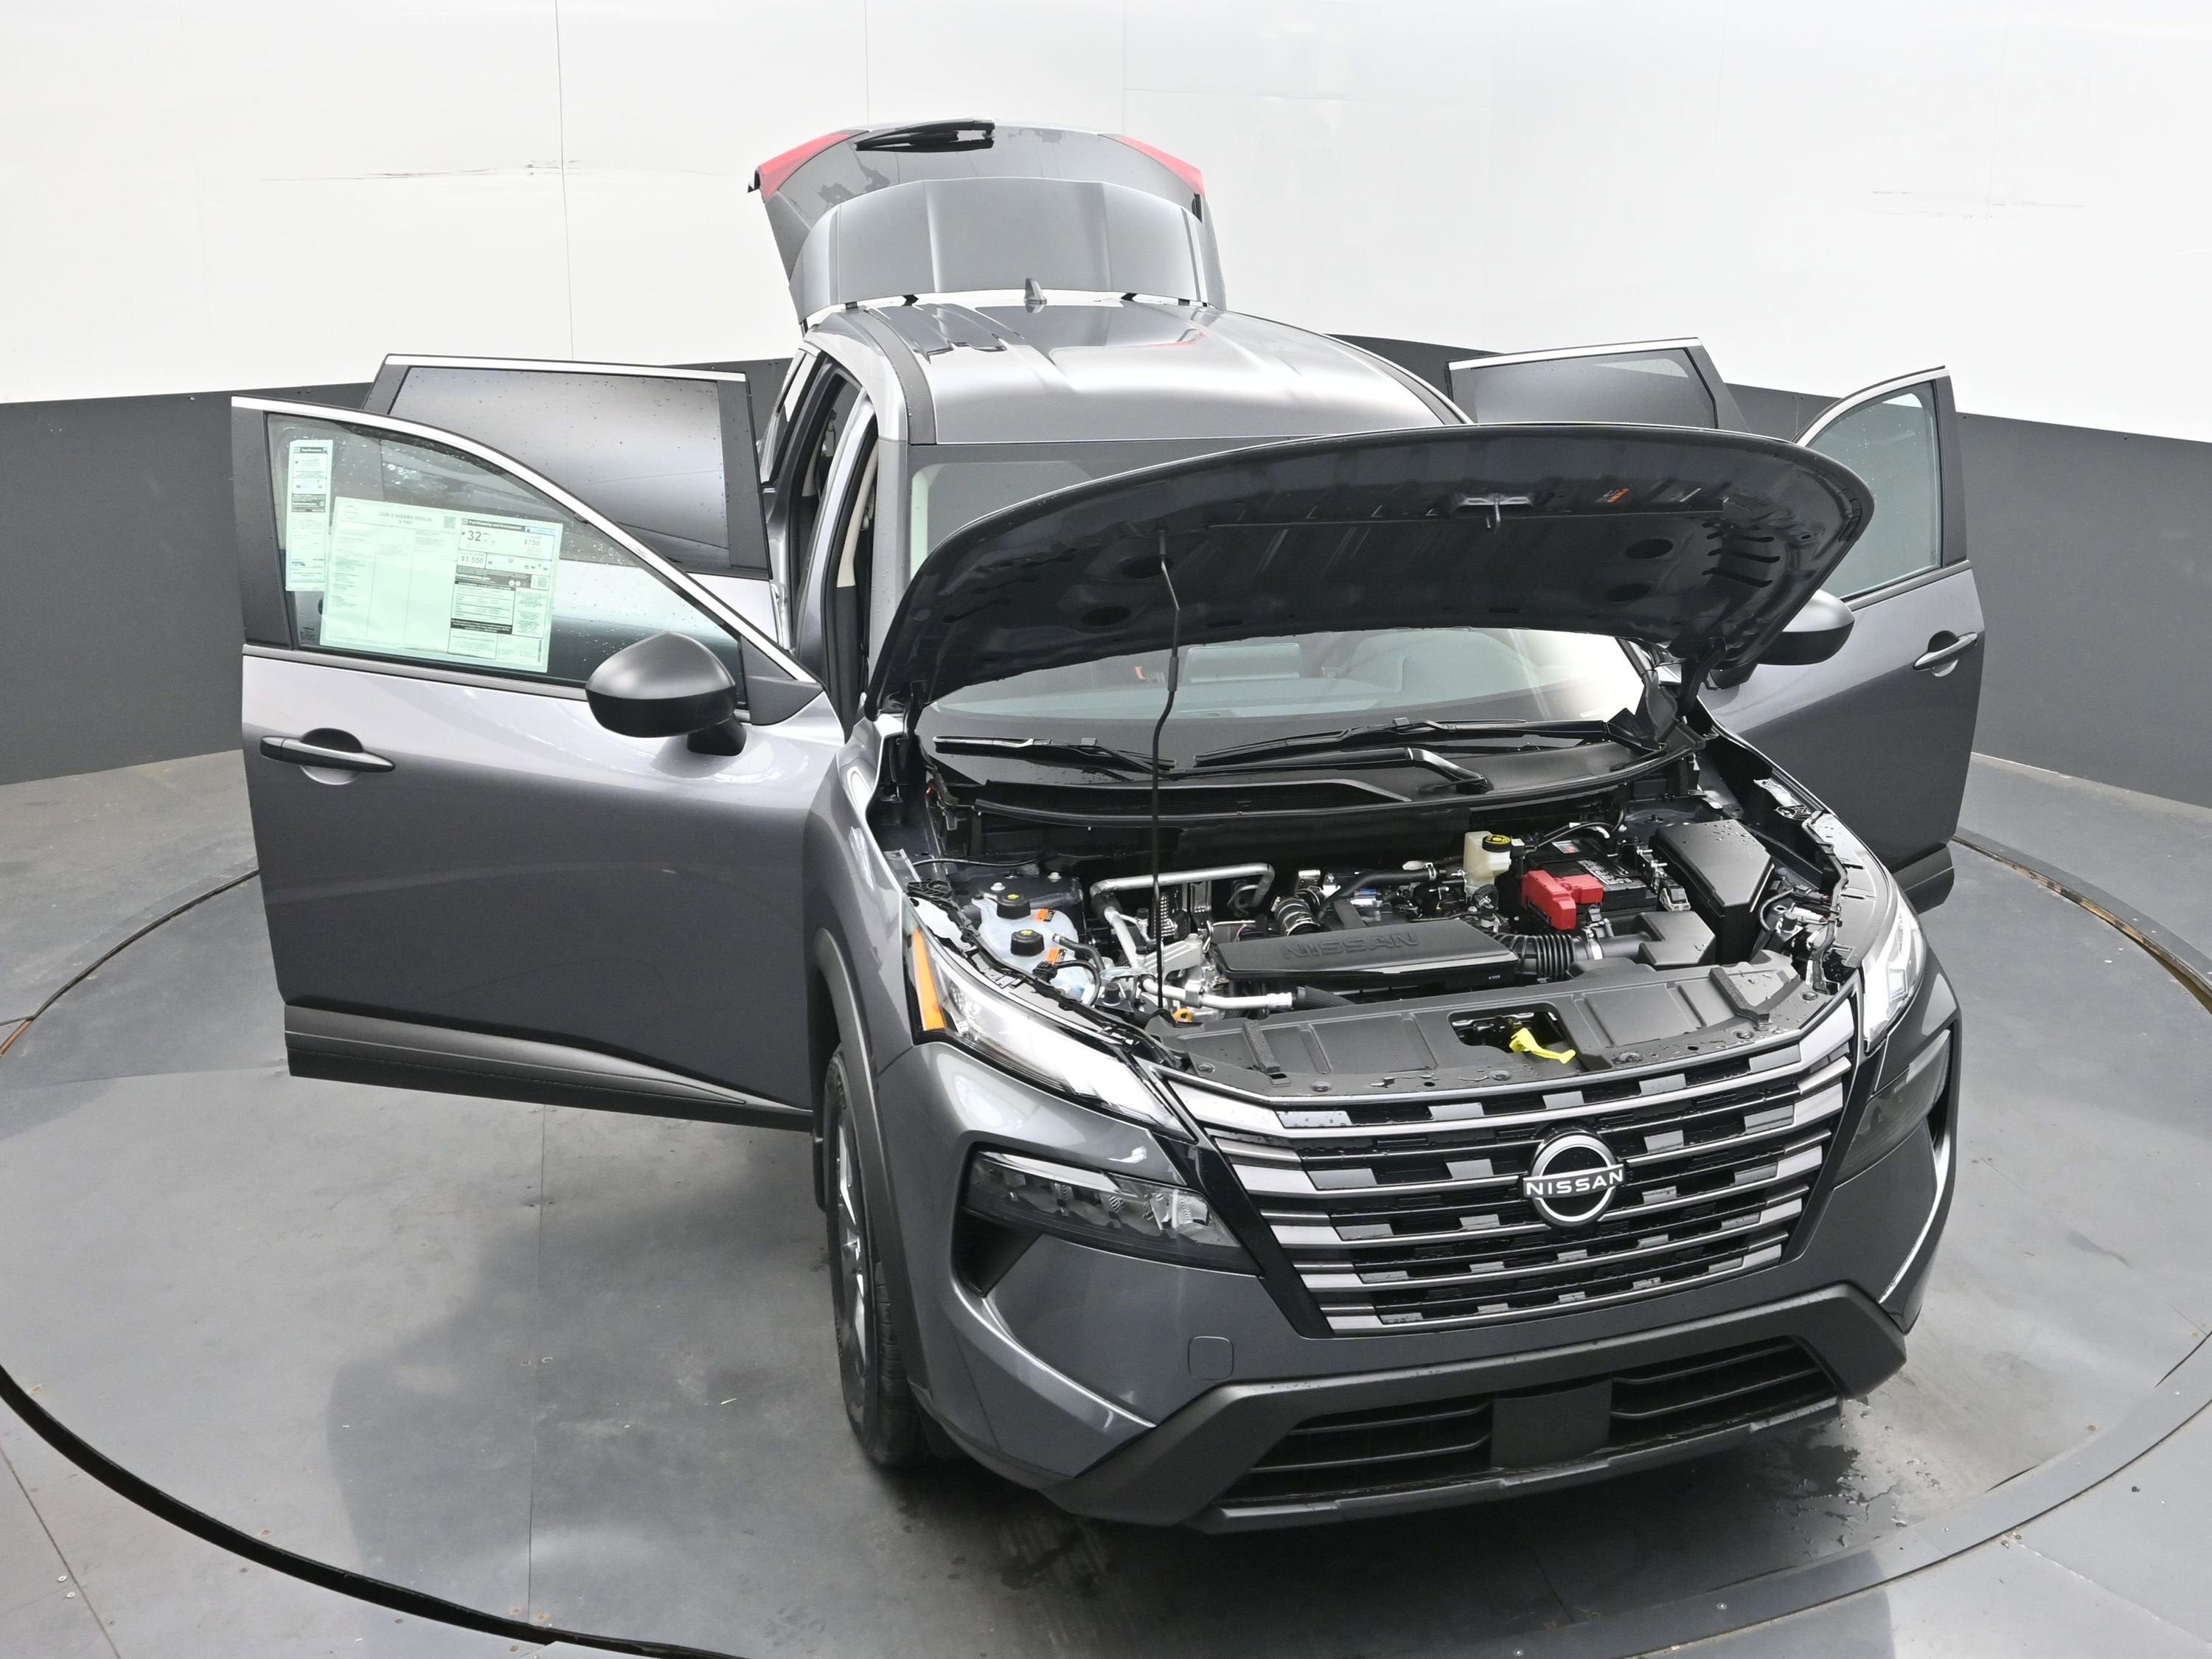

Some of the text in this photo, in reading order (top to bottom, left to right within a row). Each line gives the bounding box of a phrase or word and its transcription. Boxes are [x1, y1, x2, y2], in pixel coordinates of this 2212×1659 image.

[467, 530, 481, 542] 32
[524, 538, 540, 546] $750
[1283, 932, 1419, 959] NISSAN
[1526, 1169, 1623, 1196] NISSAN
